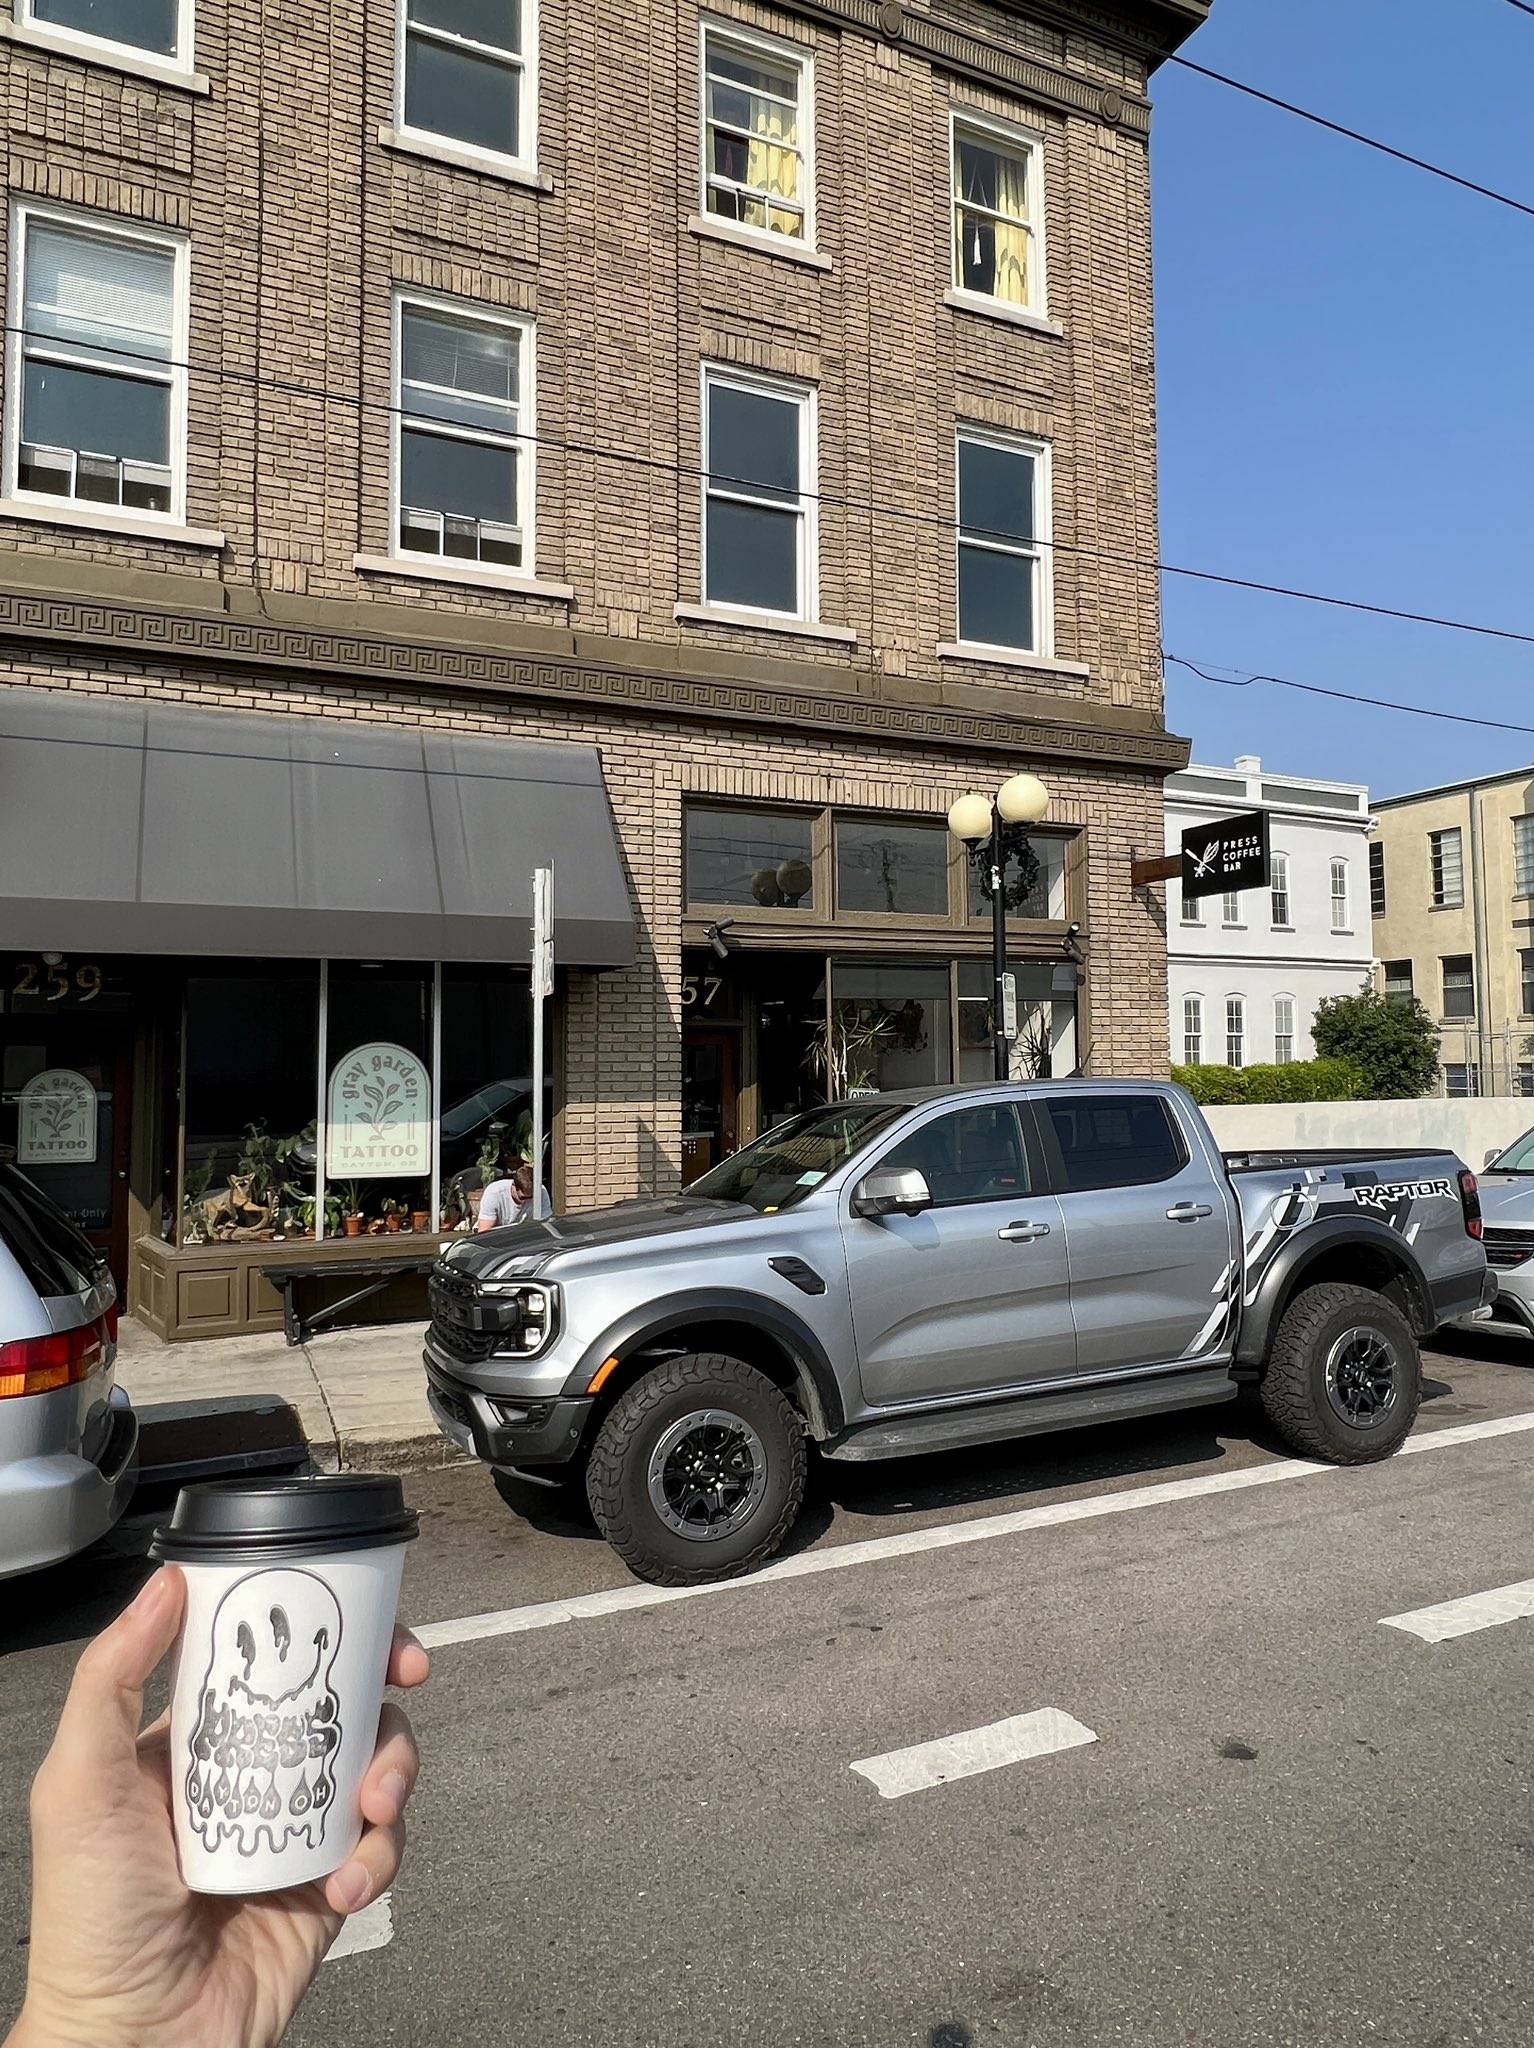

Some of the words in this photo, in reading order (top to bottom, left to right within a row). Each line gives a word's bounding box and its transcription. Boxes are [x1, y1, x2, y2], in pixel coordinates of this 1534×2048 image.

[1223, 835, 1258, 850] PRESS
[1222, 846, 1261, 861] COFFEE
[1223, 862, 1241, 872] BAR
[12, 963, 102, 1001] 259
[342, 1062, 368, 1099] gray
[371, 1055, 418, 1099] garden
[27, 1140, 88, 1151] TATTOO
[340, 1144, 418, 1158] TATTOO
[1352, 1178, 1459, 1211] RAPTOR
